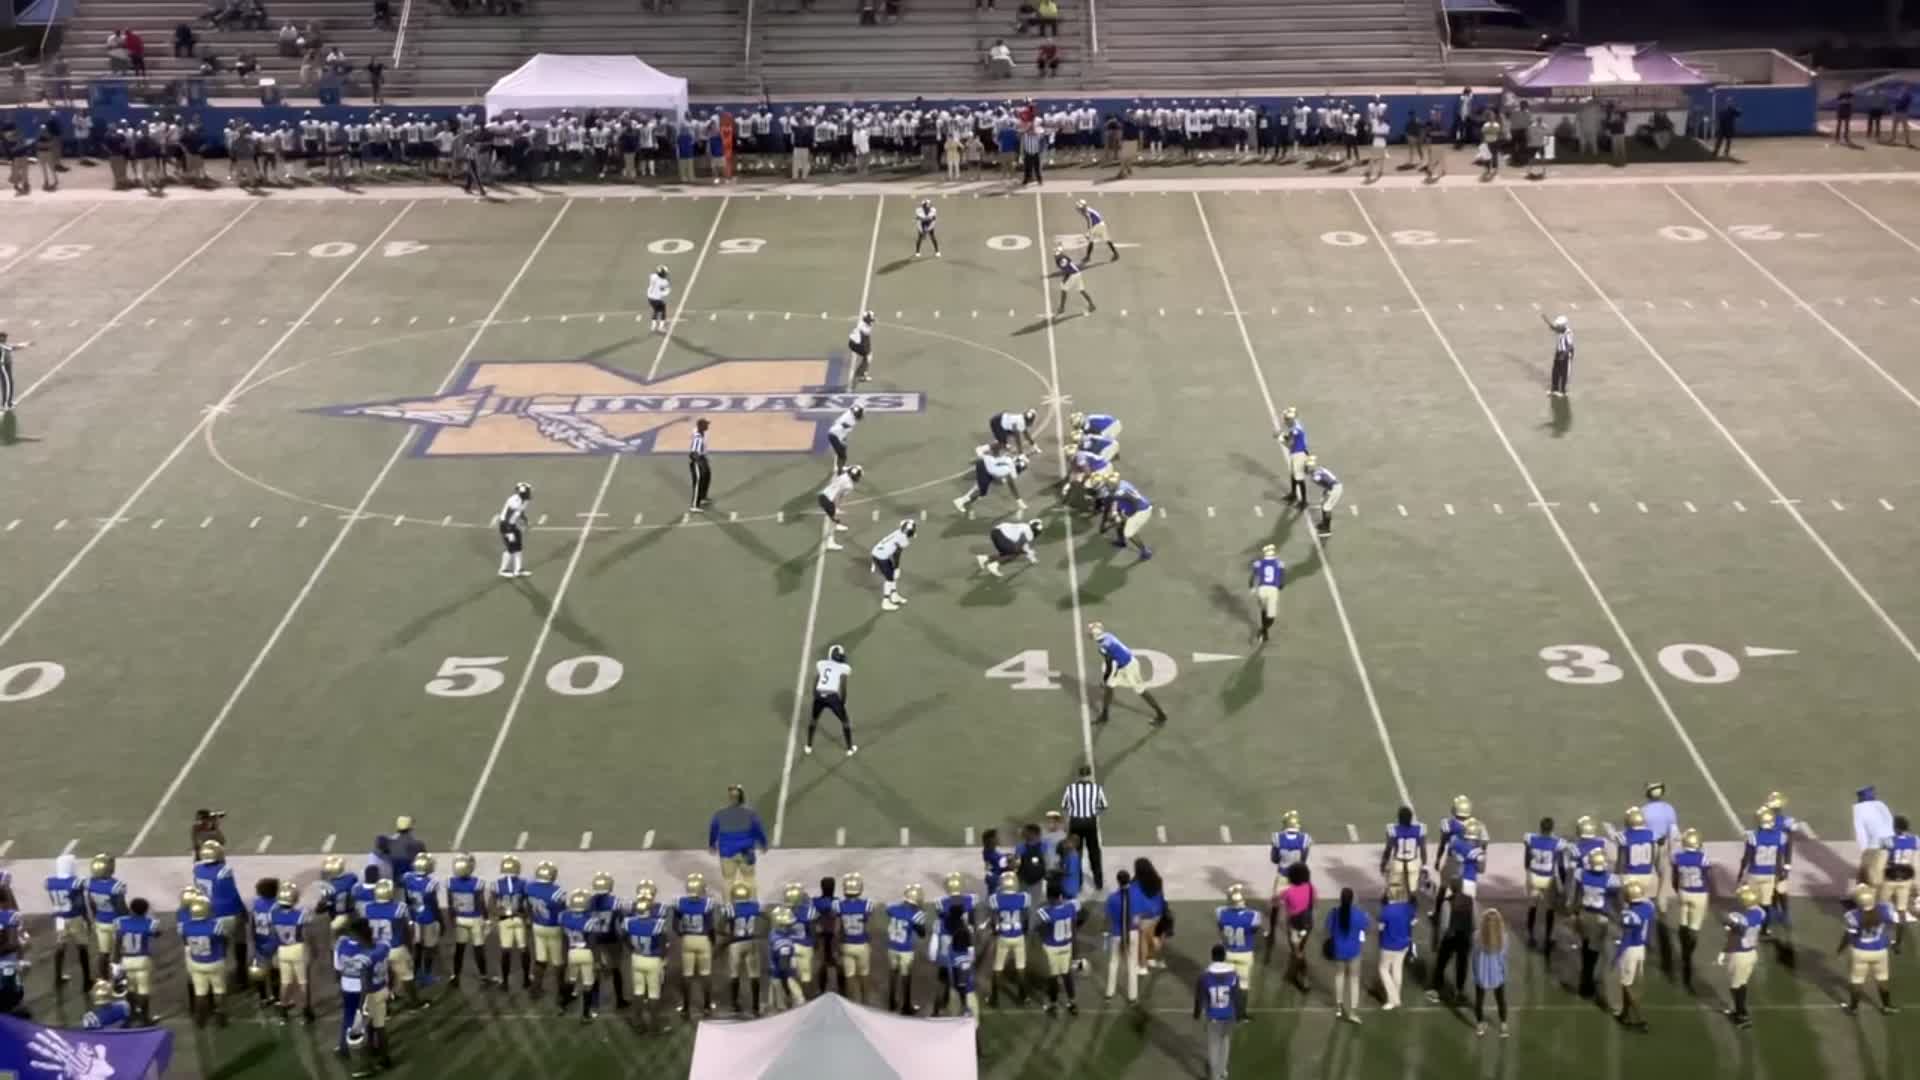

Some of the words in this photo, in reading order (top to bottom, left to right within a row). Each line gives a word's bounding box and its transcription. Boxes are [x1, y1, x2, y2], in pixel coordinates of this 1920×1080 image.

[1584, 44, 1641, 82] N
[648, 238, 767, 254] 50
[588, 395, 905, 413] INDIANS
[1264, 565, 1275, 583] 9
[1538, 643, 1740, 684] 30
[425, 656, 624, 697] 50
[821, 667, 832, 685] 5
[1208, 986, 1230, 1009] 15
